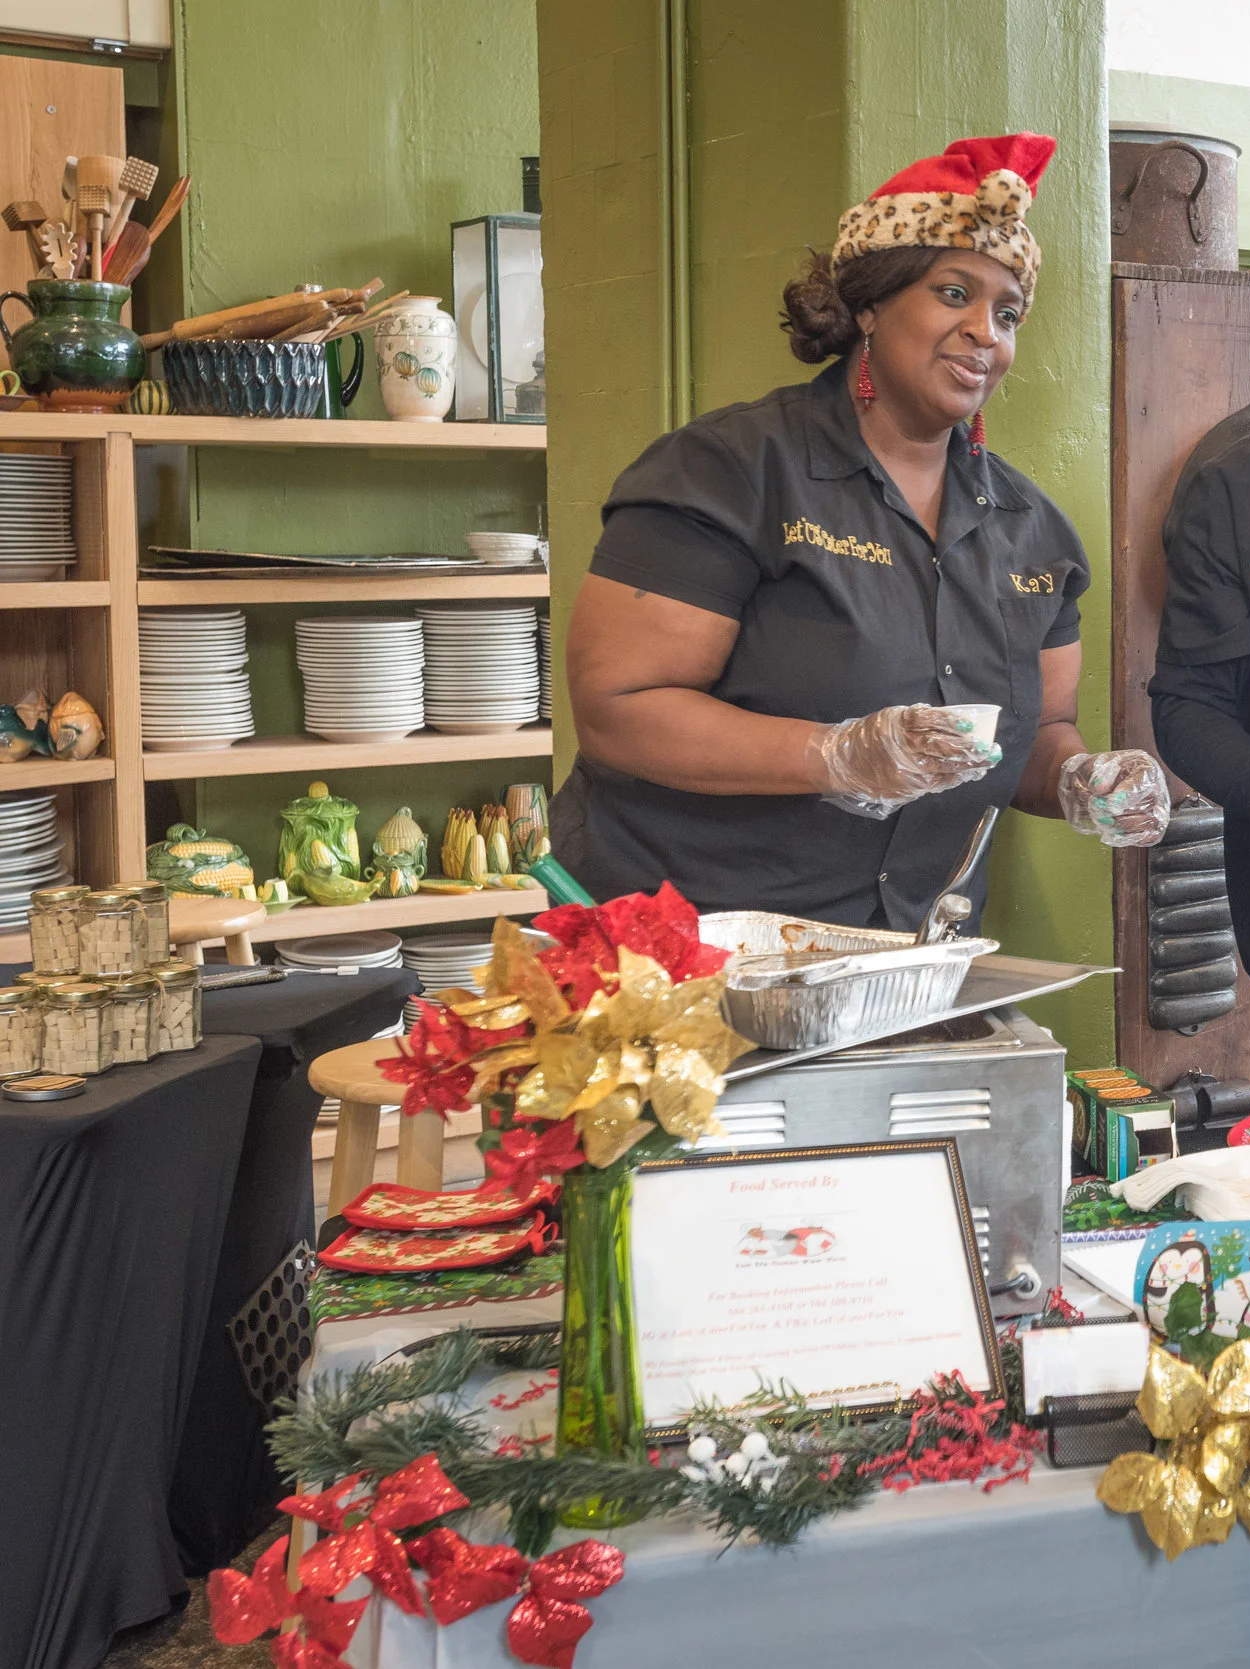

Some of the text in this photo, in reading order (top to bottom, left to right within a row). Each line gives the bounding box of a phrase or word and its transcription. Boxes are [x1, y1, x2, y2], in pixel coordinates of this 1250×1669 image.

[782, 520, 804, 545] Let
[847, 536, 868, 561] For
[867, 541, 893, 566] You
[1009, 573, 1054, 594] Kay
[729, 1175, 840, 1193] Food Served By
